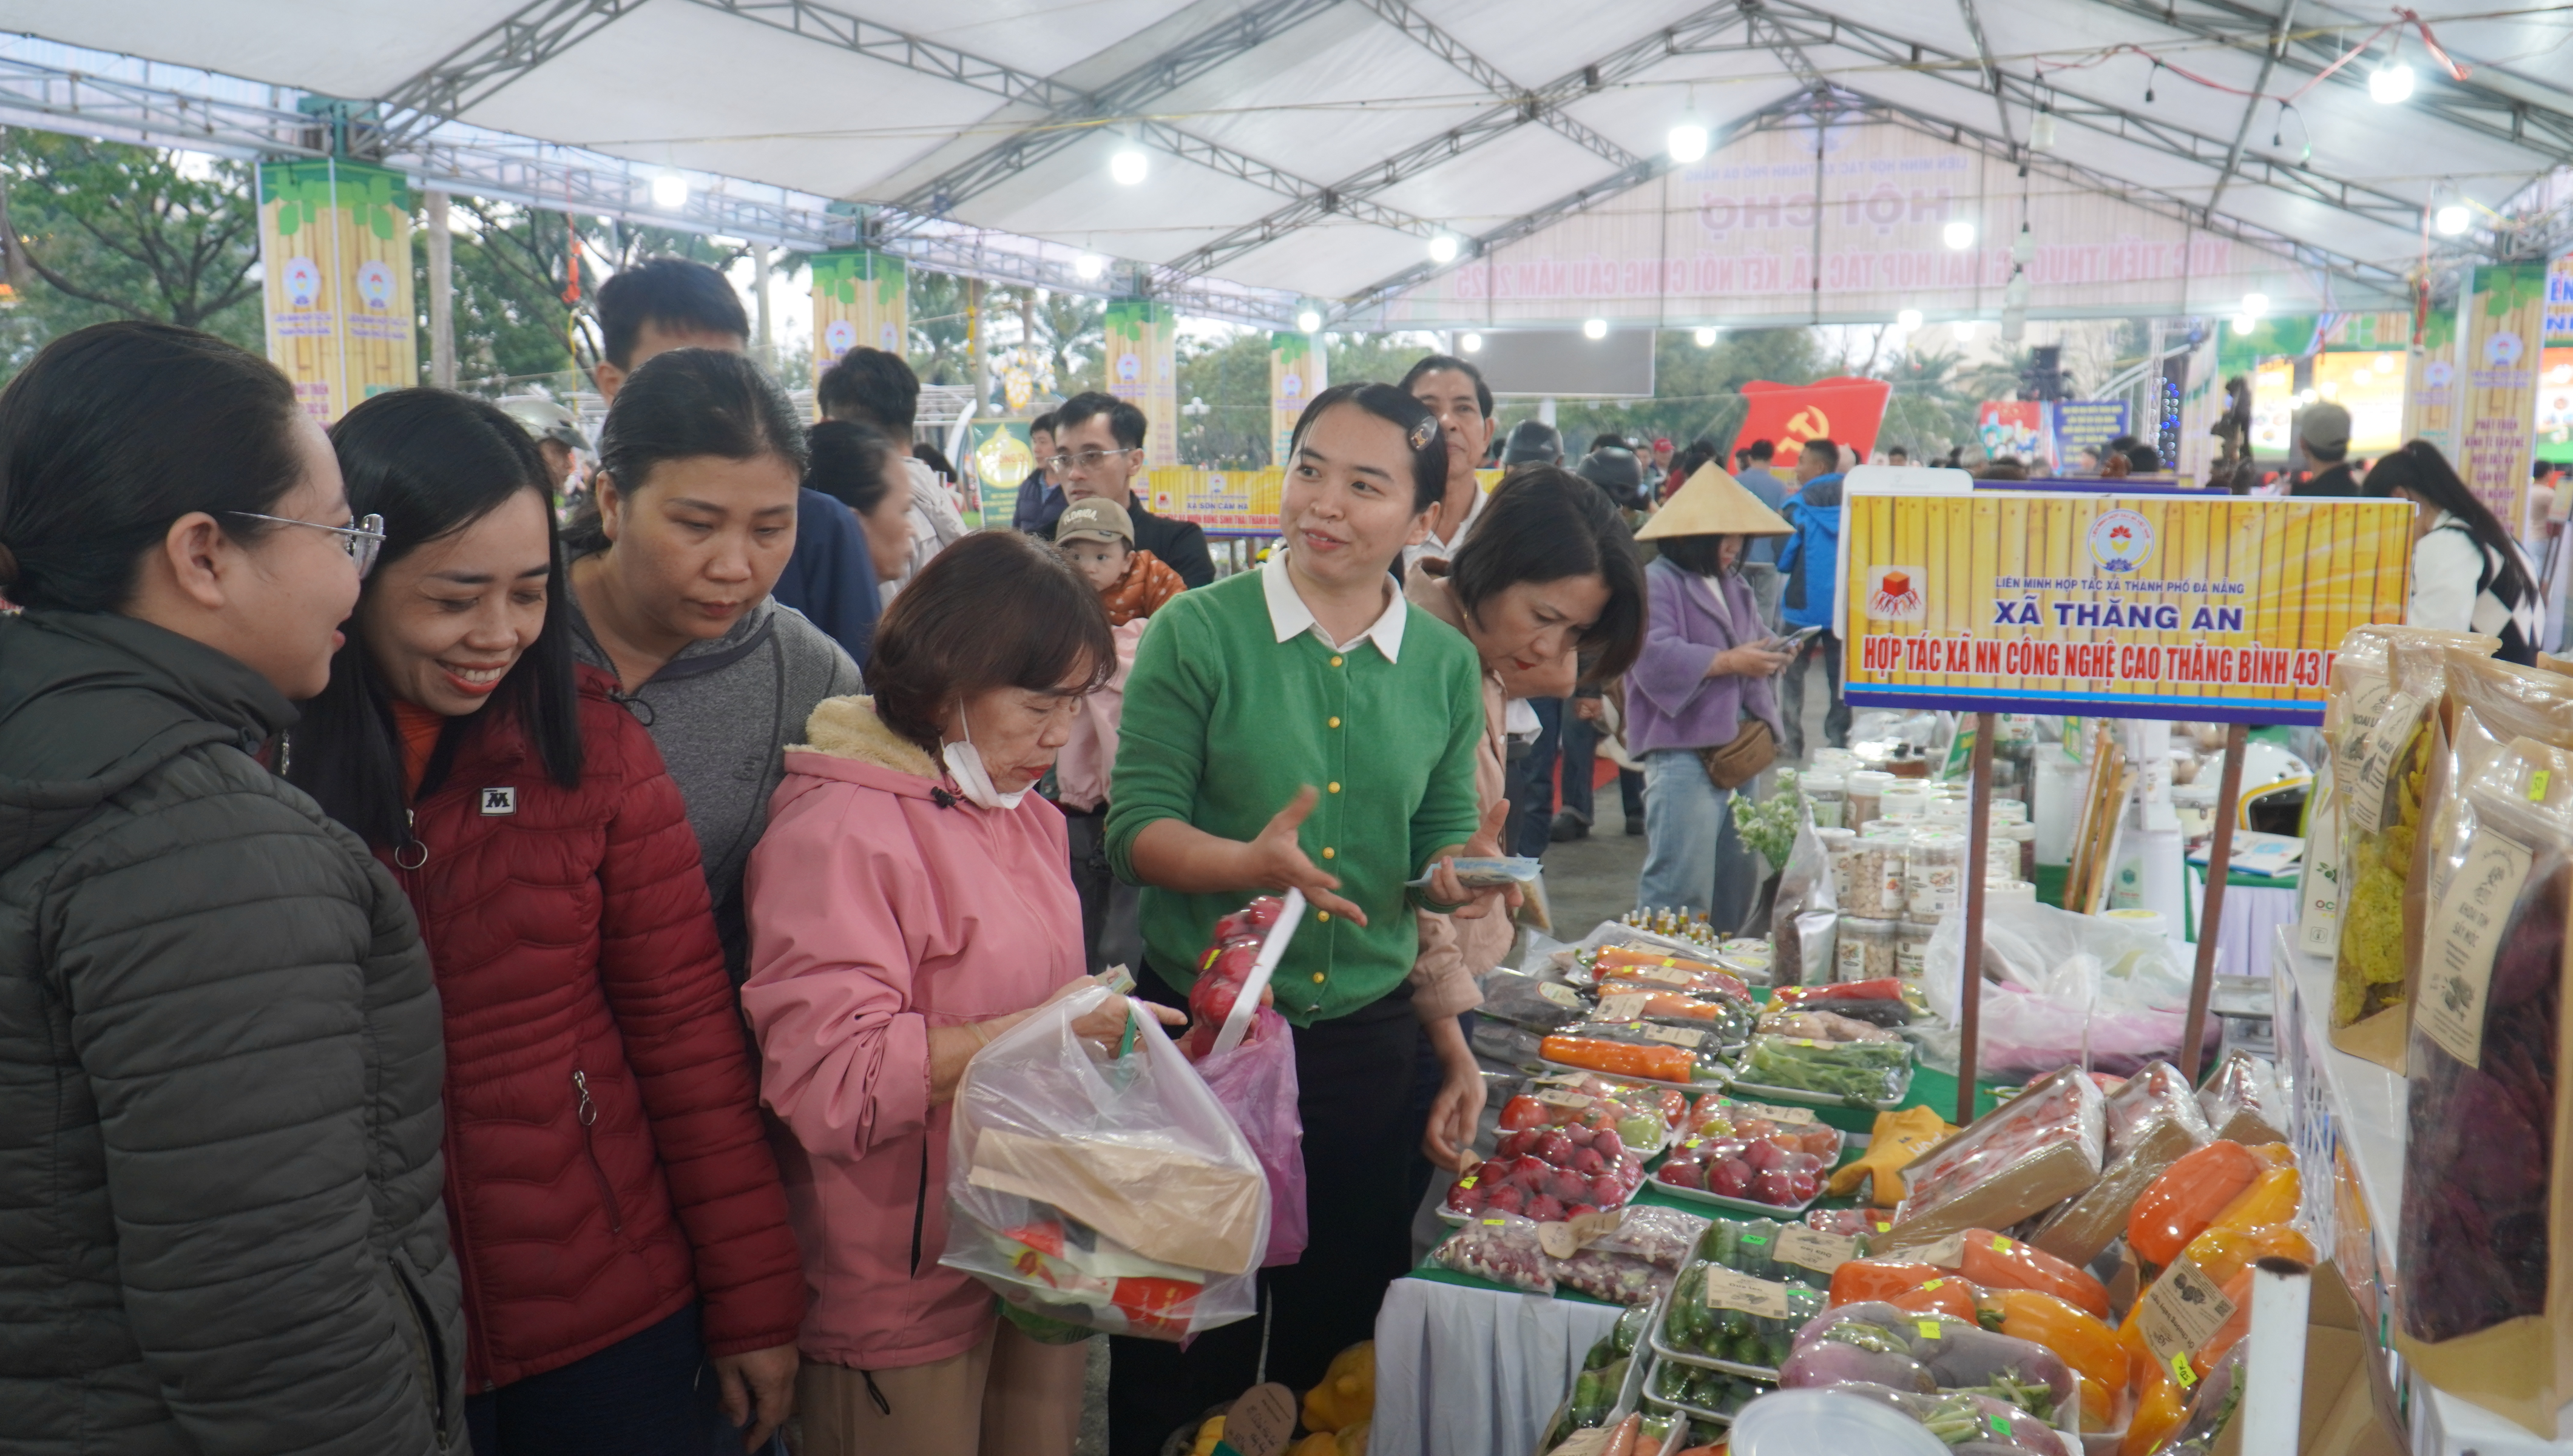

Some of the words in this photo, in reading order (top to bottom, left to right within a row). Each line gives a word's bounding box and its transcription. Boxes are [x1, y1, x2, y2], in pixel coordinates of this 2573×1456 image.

[1995, 576, 2020, 589] LIÊN
[2024, 578, 2052, 589] MINH
[2055, 578, 2078, 592] HỢP
[2081, 576, 2103, 590] TÁC
[2106, 578, 2121, 591] XÃ
[2125, 578, 2163, 592] THÀNH
[2166, 577, 2189, 593] PHỐ
[2193, 579, 2208, 593] ĐÀ
[2212, 577, 2245, 594] NẴNG
[1994, 593, 2042, 625] XÃ
[2054, 598, 2179, 629] THĂNG
[2191, 606, 2243, 631] AN
[1864, 635, 1902, 678] HỢP
[1907, 631, 1941, 672] TÁC
[1946, 633, 1971, 672] XÃ
[1975, 641, 2001, 673] NN
[2006, 635, 2060, 676] CÔNG
[2064, 640, 2115, 687] NGHỆ
[2122, 645, 2161, 680] CAO
[2166, 641, 2234, 682] THĂNG
[2238, 643, 2290, 685] BÌNH
[2293, 651, 2321, 686] 43
[2314, 900, 2335, 909] OC
